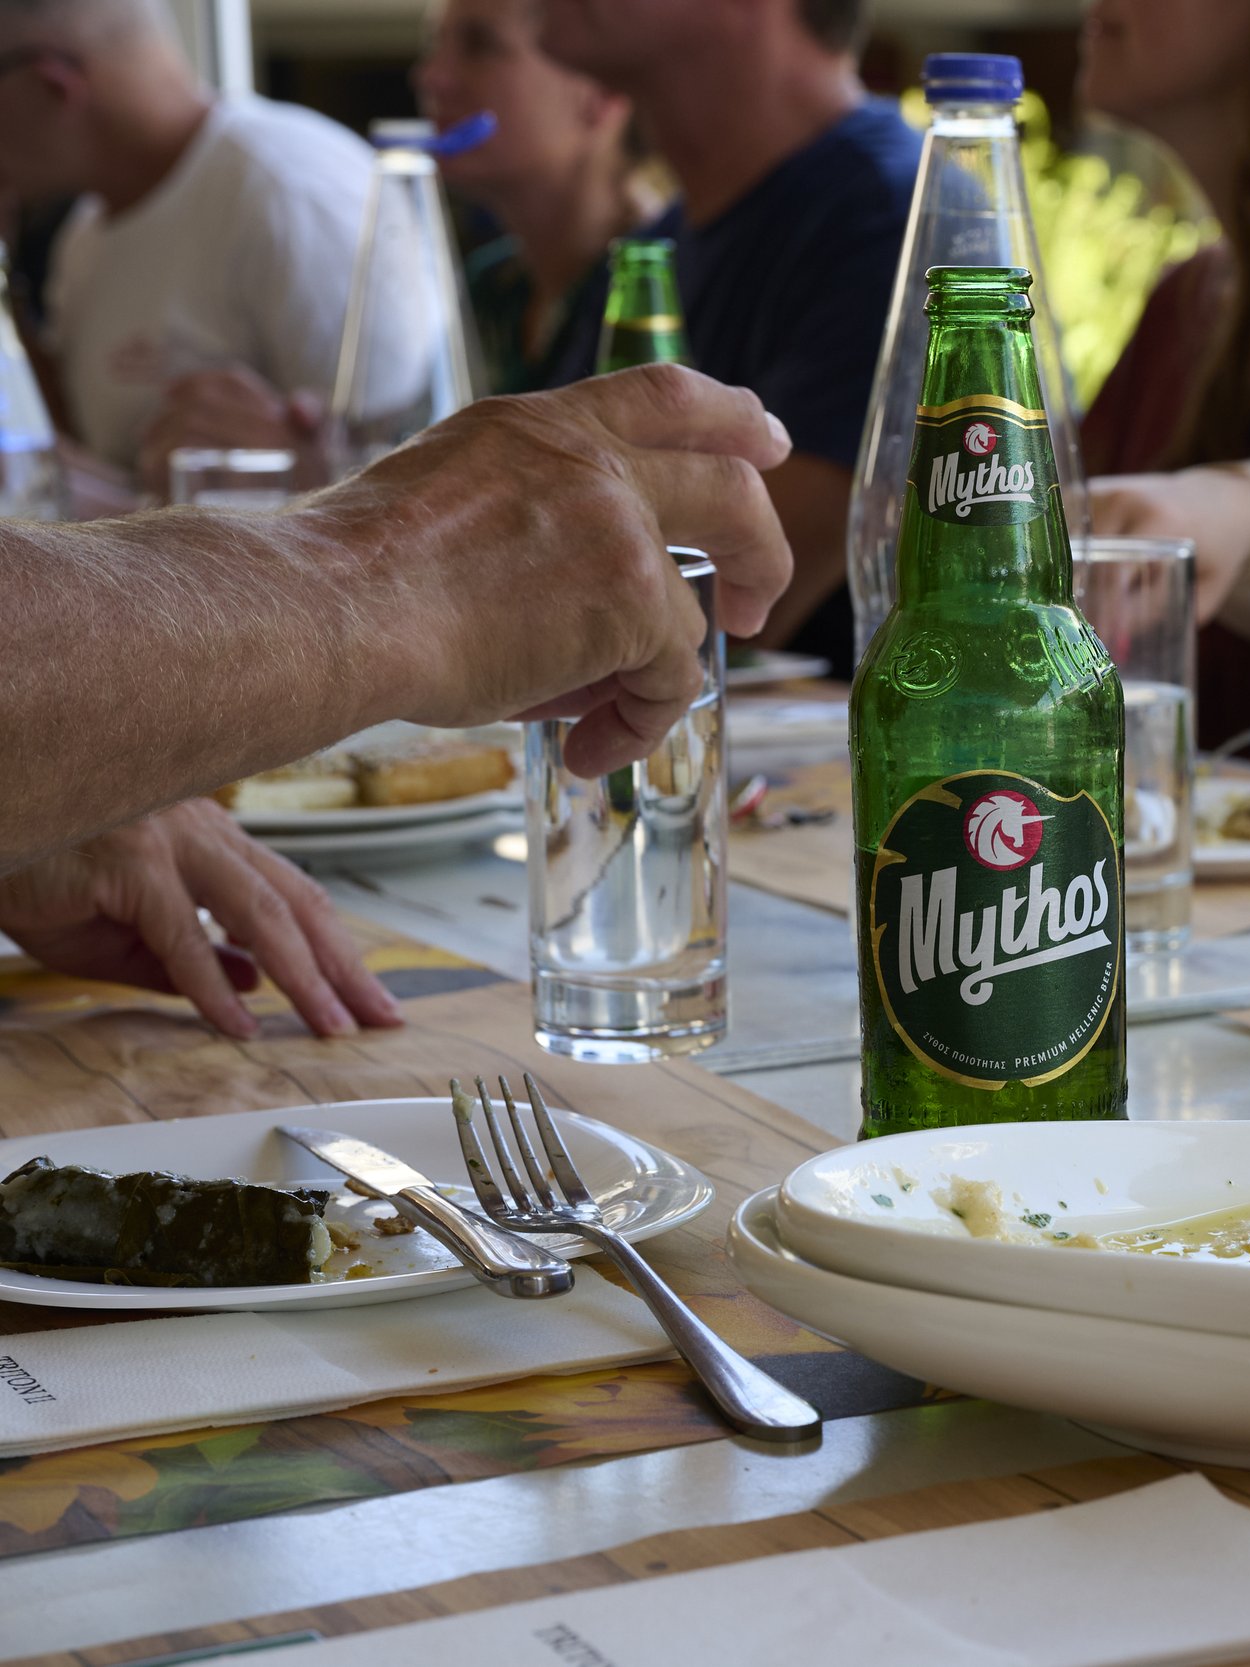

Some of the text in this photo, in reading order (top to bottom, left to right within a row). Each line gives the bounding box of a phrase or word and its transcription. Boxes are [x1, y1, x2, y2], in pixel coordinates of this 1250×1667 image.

[928, 452, 1036, 518] Mythos
[899, 858, 1112, 1006] Mythos
[1015, 961, 1113, 1068] PREMIUM HELLENIC BEER
[923, 1031, 1006, 1070] ΖΥΘΟΣ ΠΟΙΟΤΗΤΑΣ
[532, 1622, 618, 1667] TRIT
